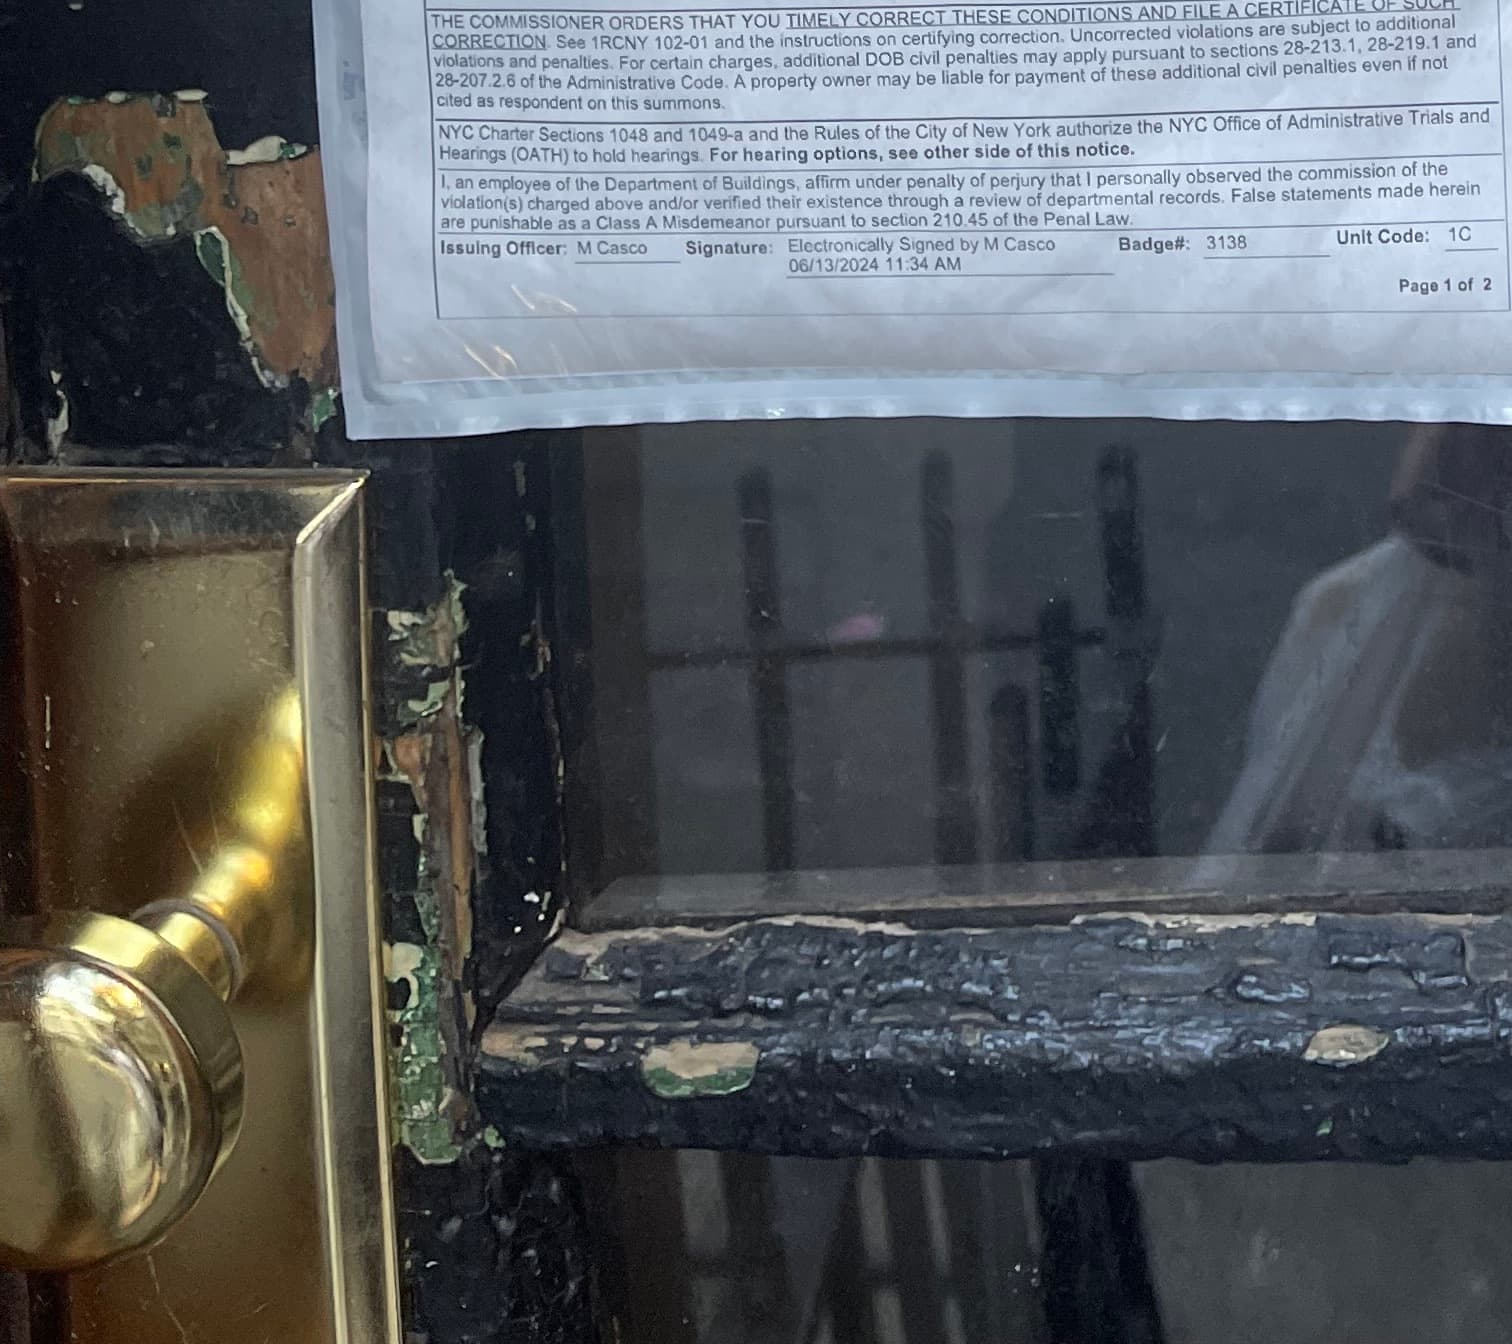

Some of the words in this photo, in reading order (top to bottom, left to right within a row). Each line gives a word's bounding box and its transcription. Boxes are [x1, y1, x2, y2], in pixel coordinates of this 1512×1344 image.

[1118, 235, 1190, 254] Badge#:
[1206, 234, 1247, 249] 3138
[1336, 228, 1373, 245] Unit
[1377, 227, 1428, 243] Code:
[1448, 225, 1471, 241] 1C
[440, 239, 501, 258] Issuing
[506, 240, 566, 255] Officer:
[576, 240, 591, 254] M
[596, 239, 647, 255] Casco
[685, 240, 772, 258] Signature:
[1399, 278, 1438, 295] Page
[1443, 277, 1450, 291] 1
[1457, 276, 1473, 291] of
[1483, 277, 1491, 290] 2
